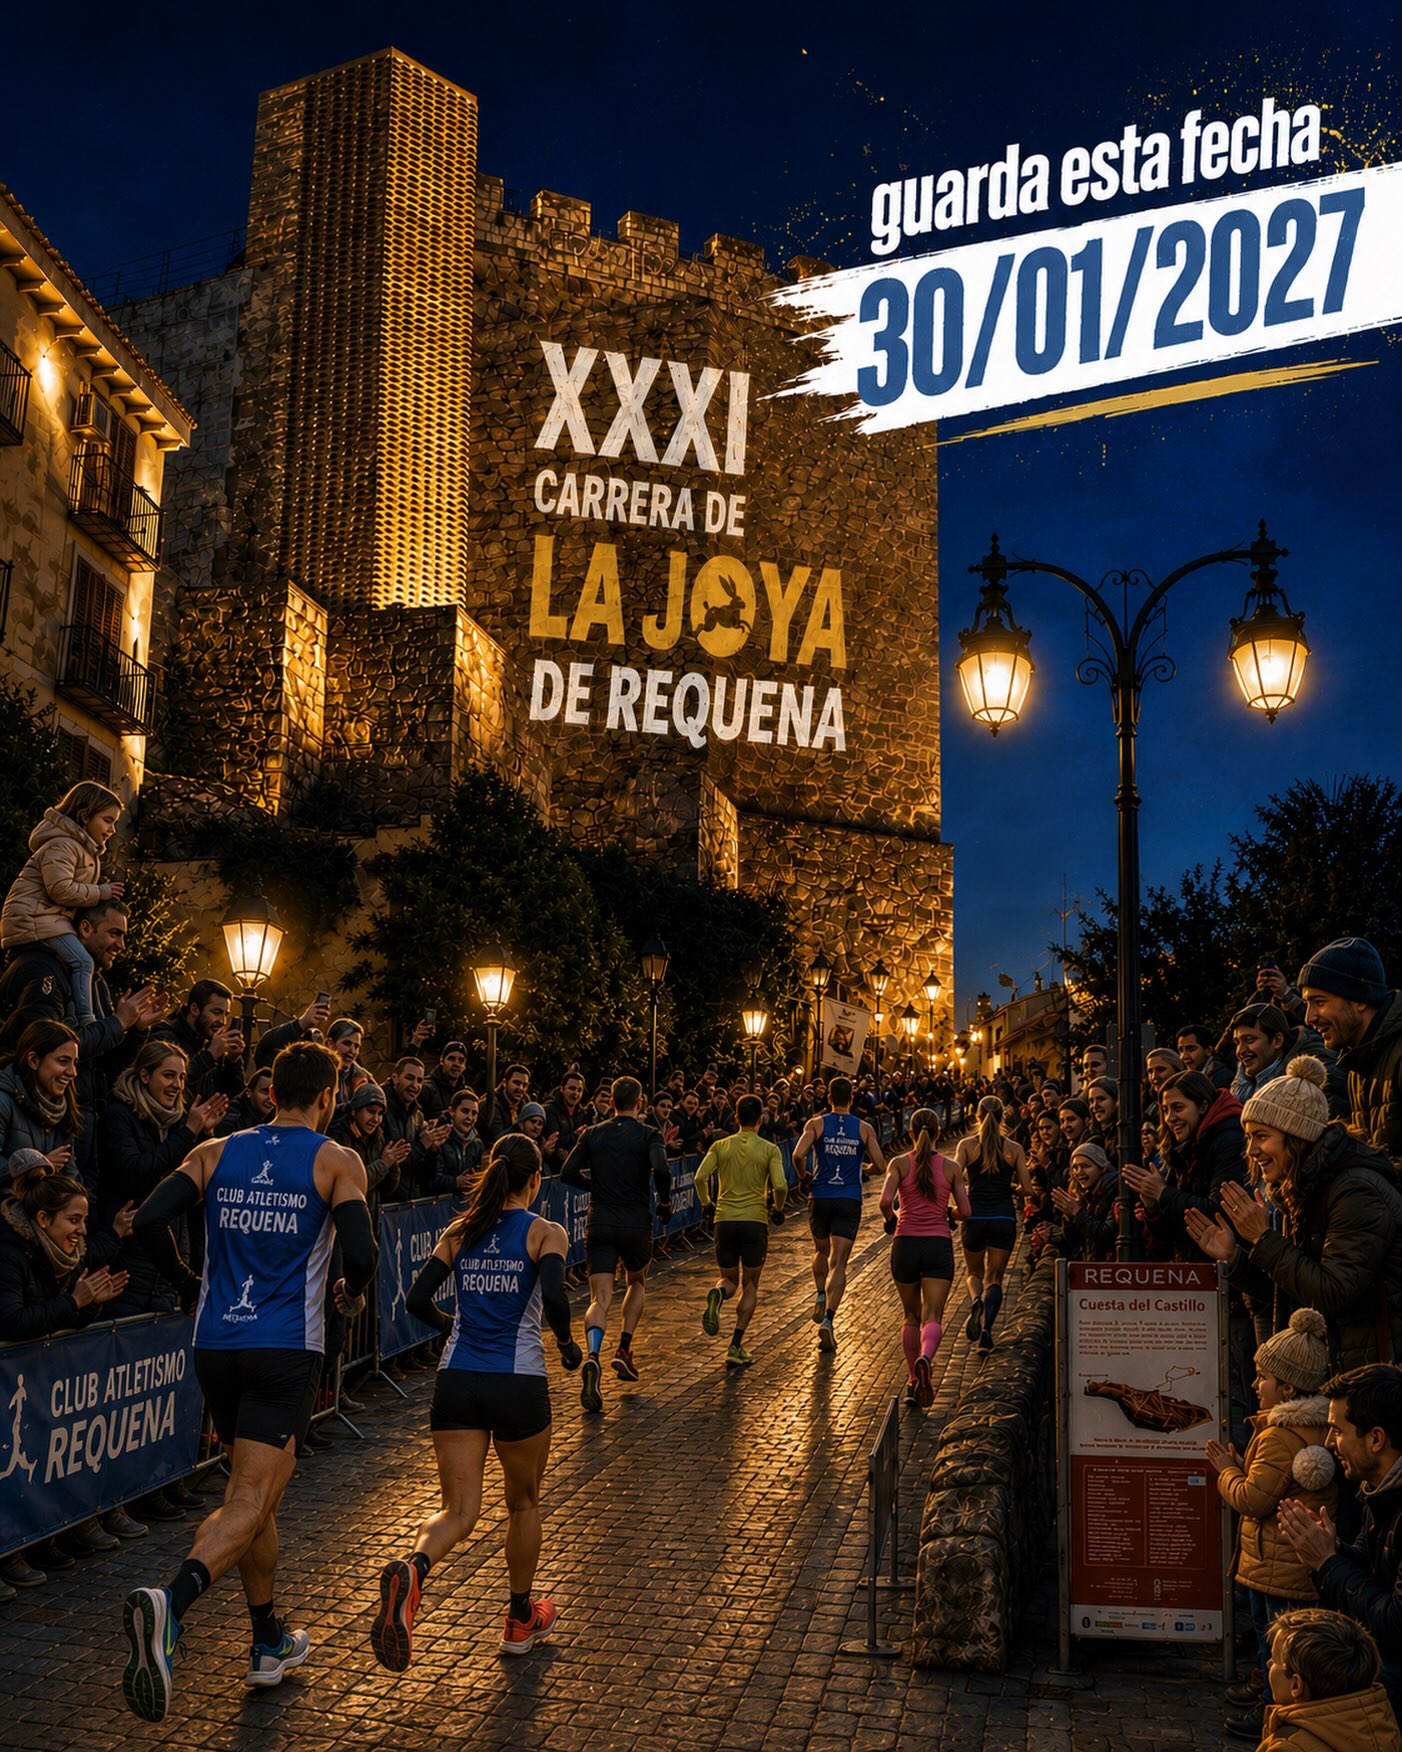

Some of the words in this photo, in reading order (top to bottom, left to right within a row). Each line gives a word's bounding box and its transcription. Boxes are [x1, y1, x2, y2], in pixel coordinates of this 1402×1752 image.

[216, 1187, 243, 1204] CLUB
[247, 1191, 308, 1209] ATLETISMO
[219, 1207, 299, 1235] REQUENA
[461, 1273, 520, 1296] REQUENA
[1084, 1268, 1201, 1284] REQUENA
[1079, 1298, 1125, 1312] Cuesta
[1128, 1298, 1151, 1312] del
[1154, 1298, 1206, 1313] Castillo
[50, 1371, 100, 1419] CLUB
[104, 1349, 186, 1404] ATLETISMO
[44, 1391, 176, 1484] REQUENA
